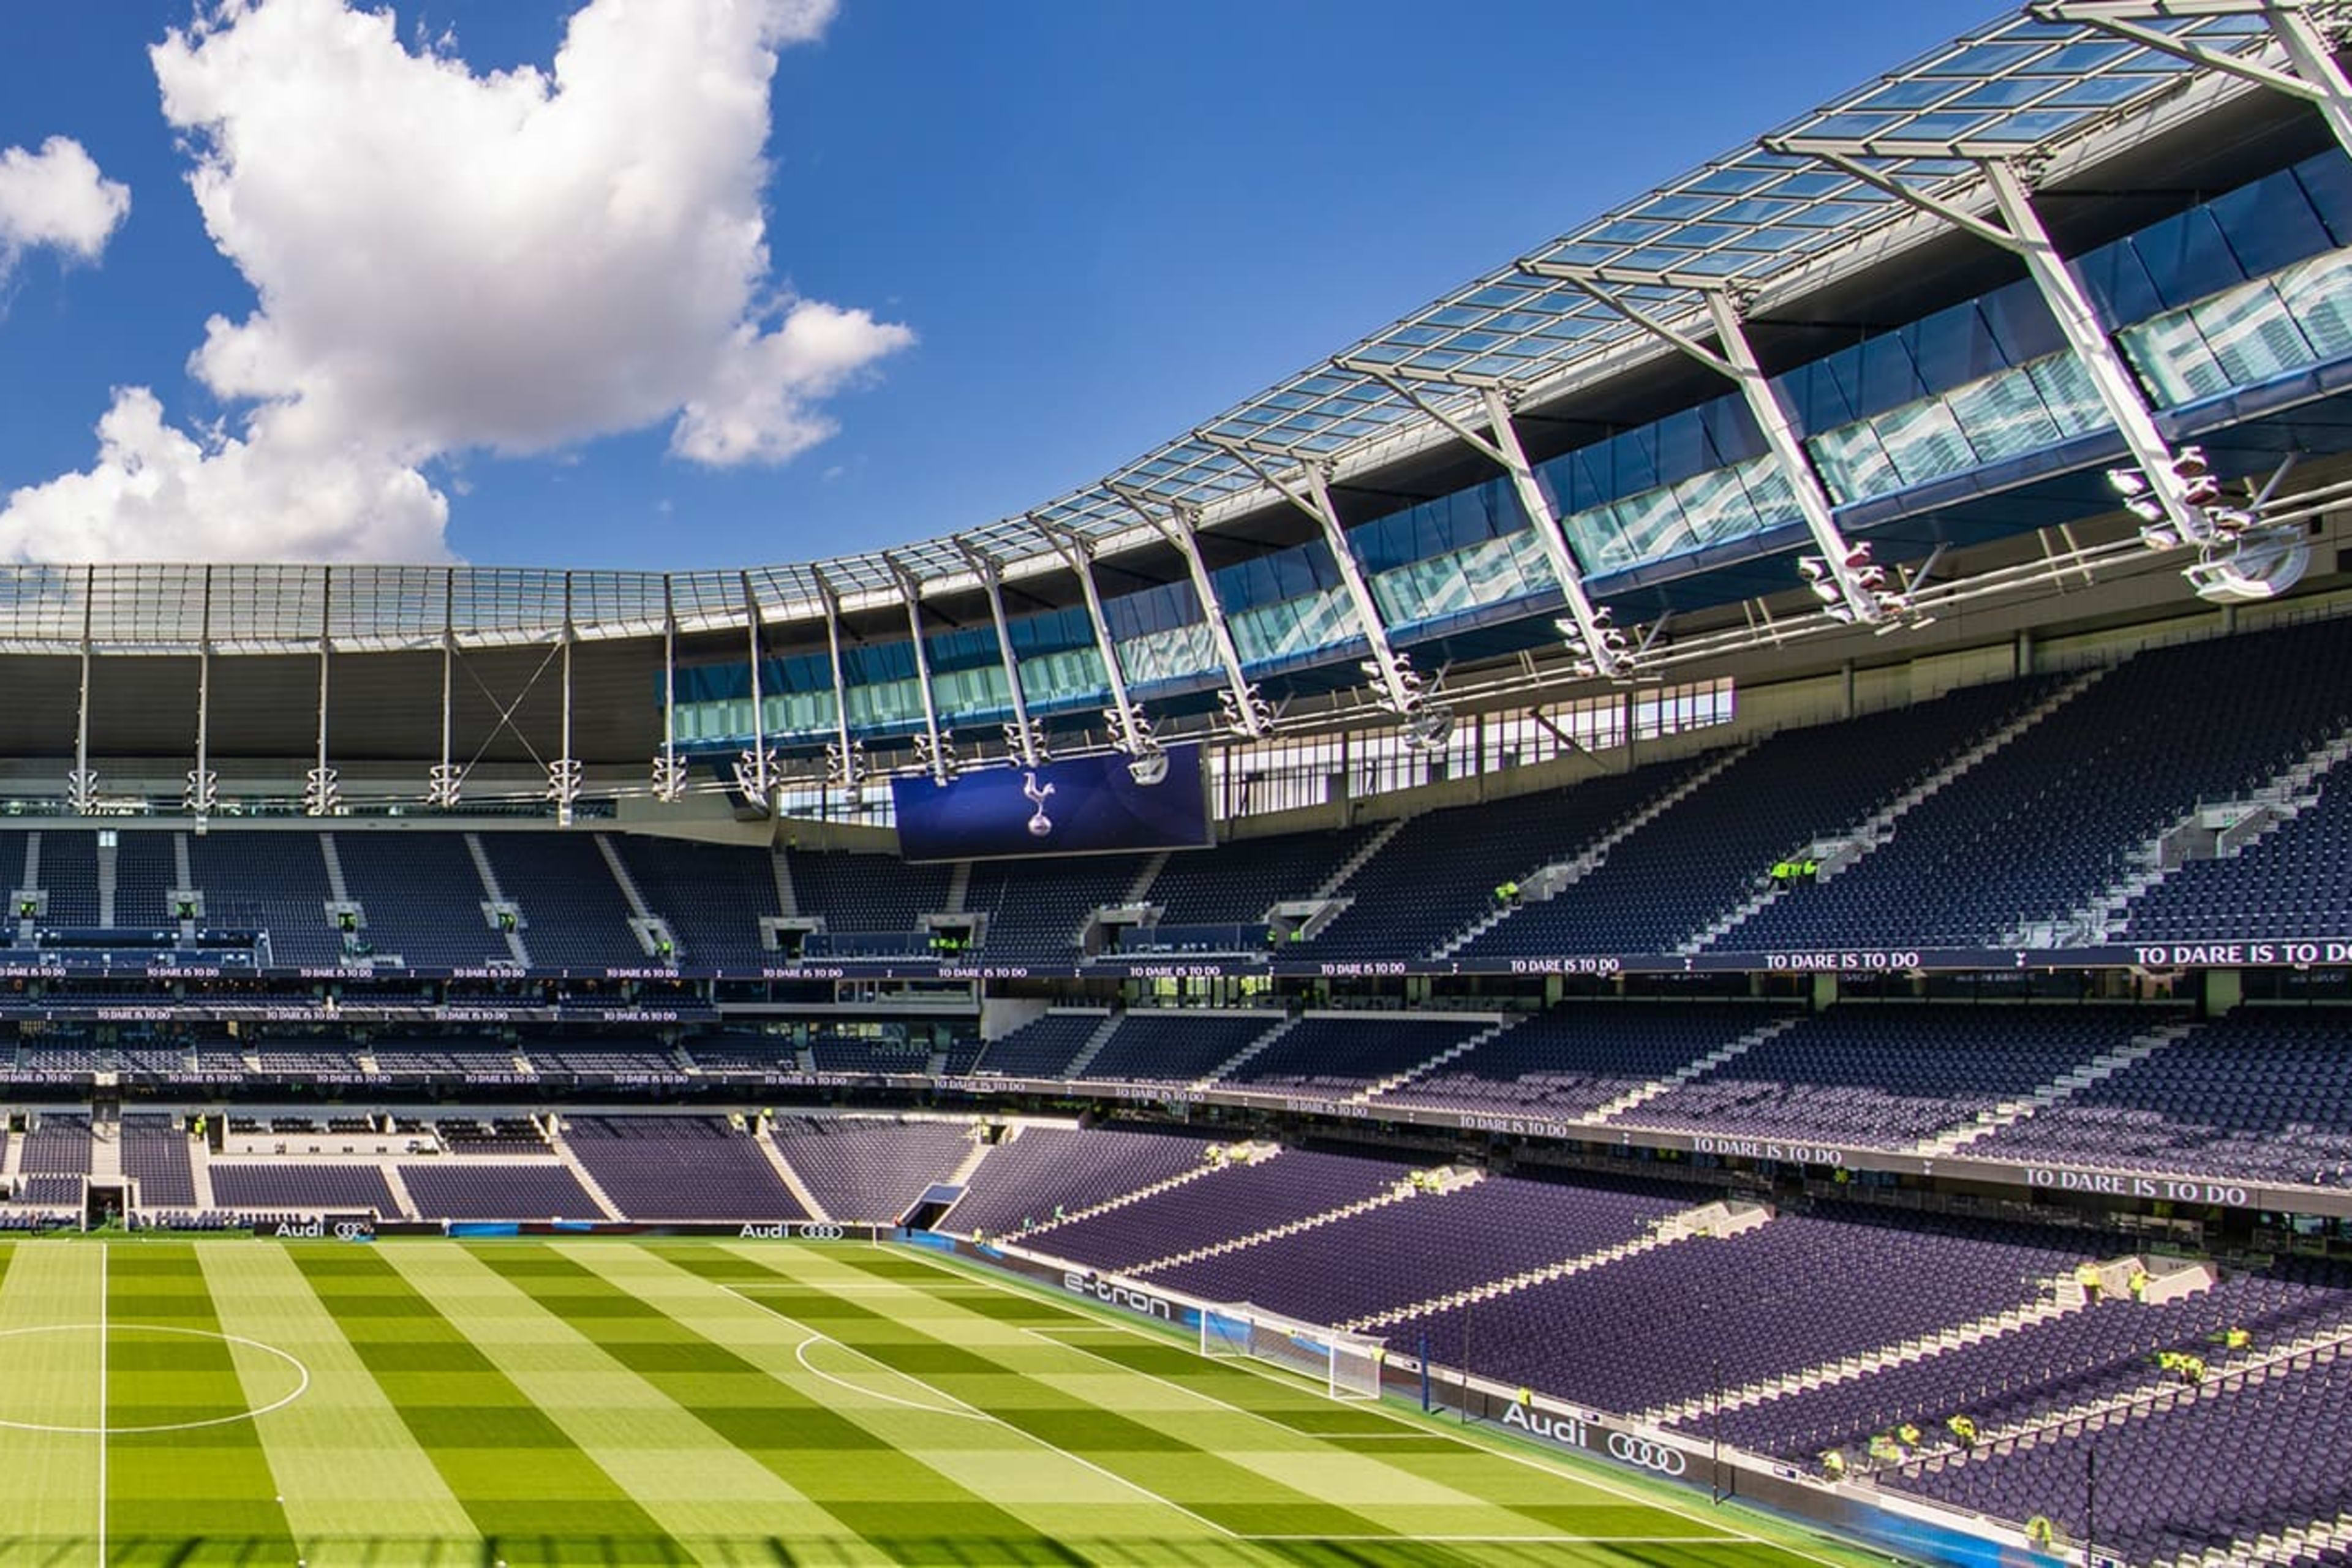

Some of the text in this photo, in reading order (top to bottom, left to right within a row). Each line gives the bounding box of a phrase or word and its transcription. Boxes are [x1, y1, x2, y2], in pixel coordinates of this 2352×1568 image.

[1766, 951, 1920, 969] TO DARE IS TO DO
[2135, 943, 2352, 964] TO DARE IS TO D
[1011, 968, 1027, 978] DO
[1189, 966, 1202, 976] TO
[1205, 966, 1220, 976] DO
[1321, 964, 1335, 974] TO
[1375, 963, 1388, 974] TO
[1390, 962, 1406, 974] DO
[1510, 959, 1619, 973] TO DARE IS TO DO
[1460, 1116, 1567, 1137] TO DARE IS TO DO
[1694, 1137, 1842, 1165] TO DARE IS TO DO
[2025, 1167, 2247, 1206] TO DARE IS TO DO
[276, 1222, 323, 1237] Audi
[739, 1223, 789, 1238] Audi
[1065, 1272, 1170, 1319] e-tron
[1503, 1401, 1586, 1447] Audi
